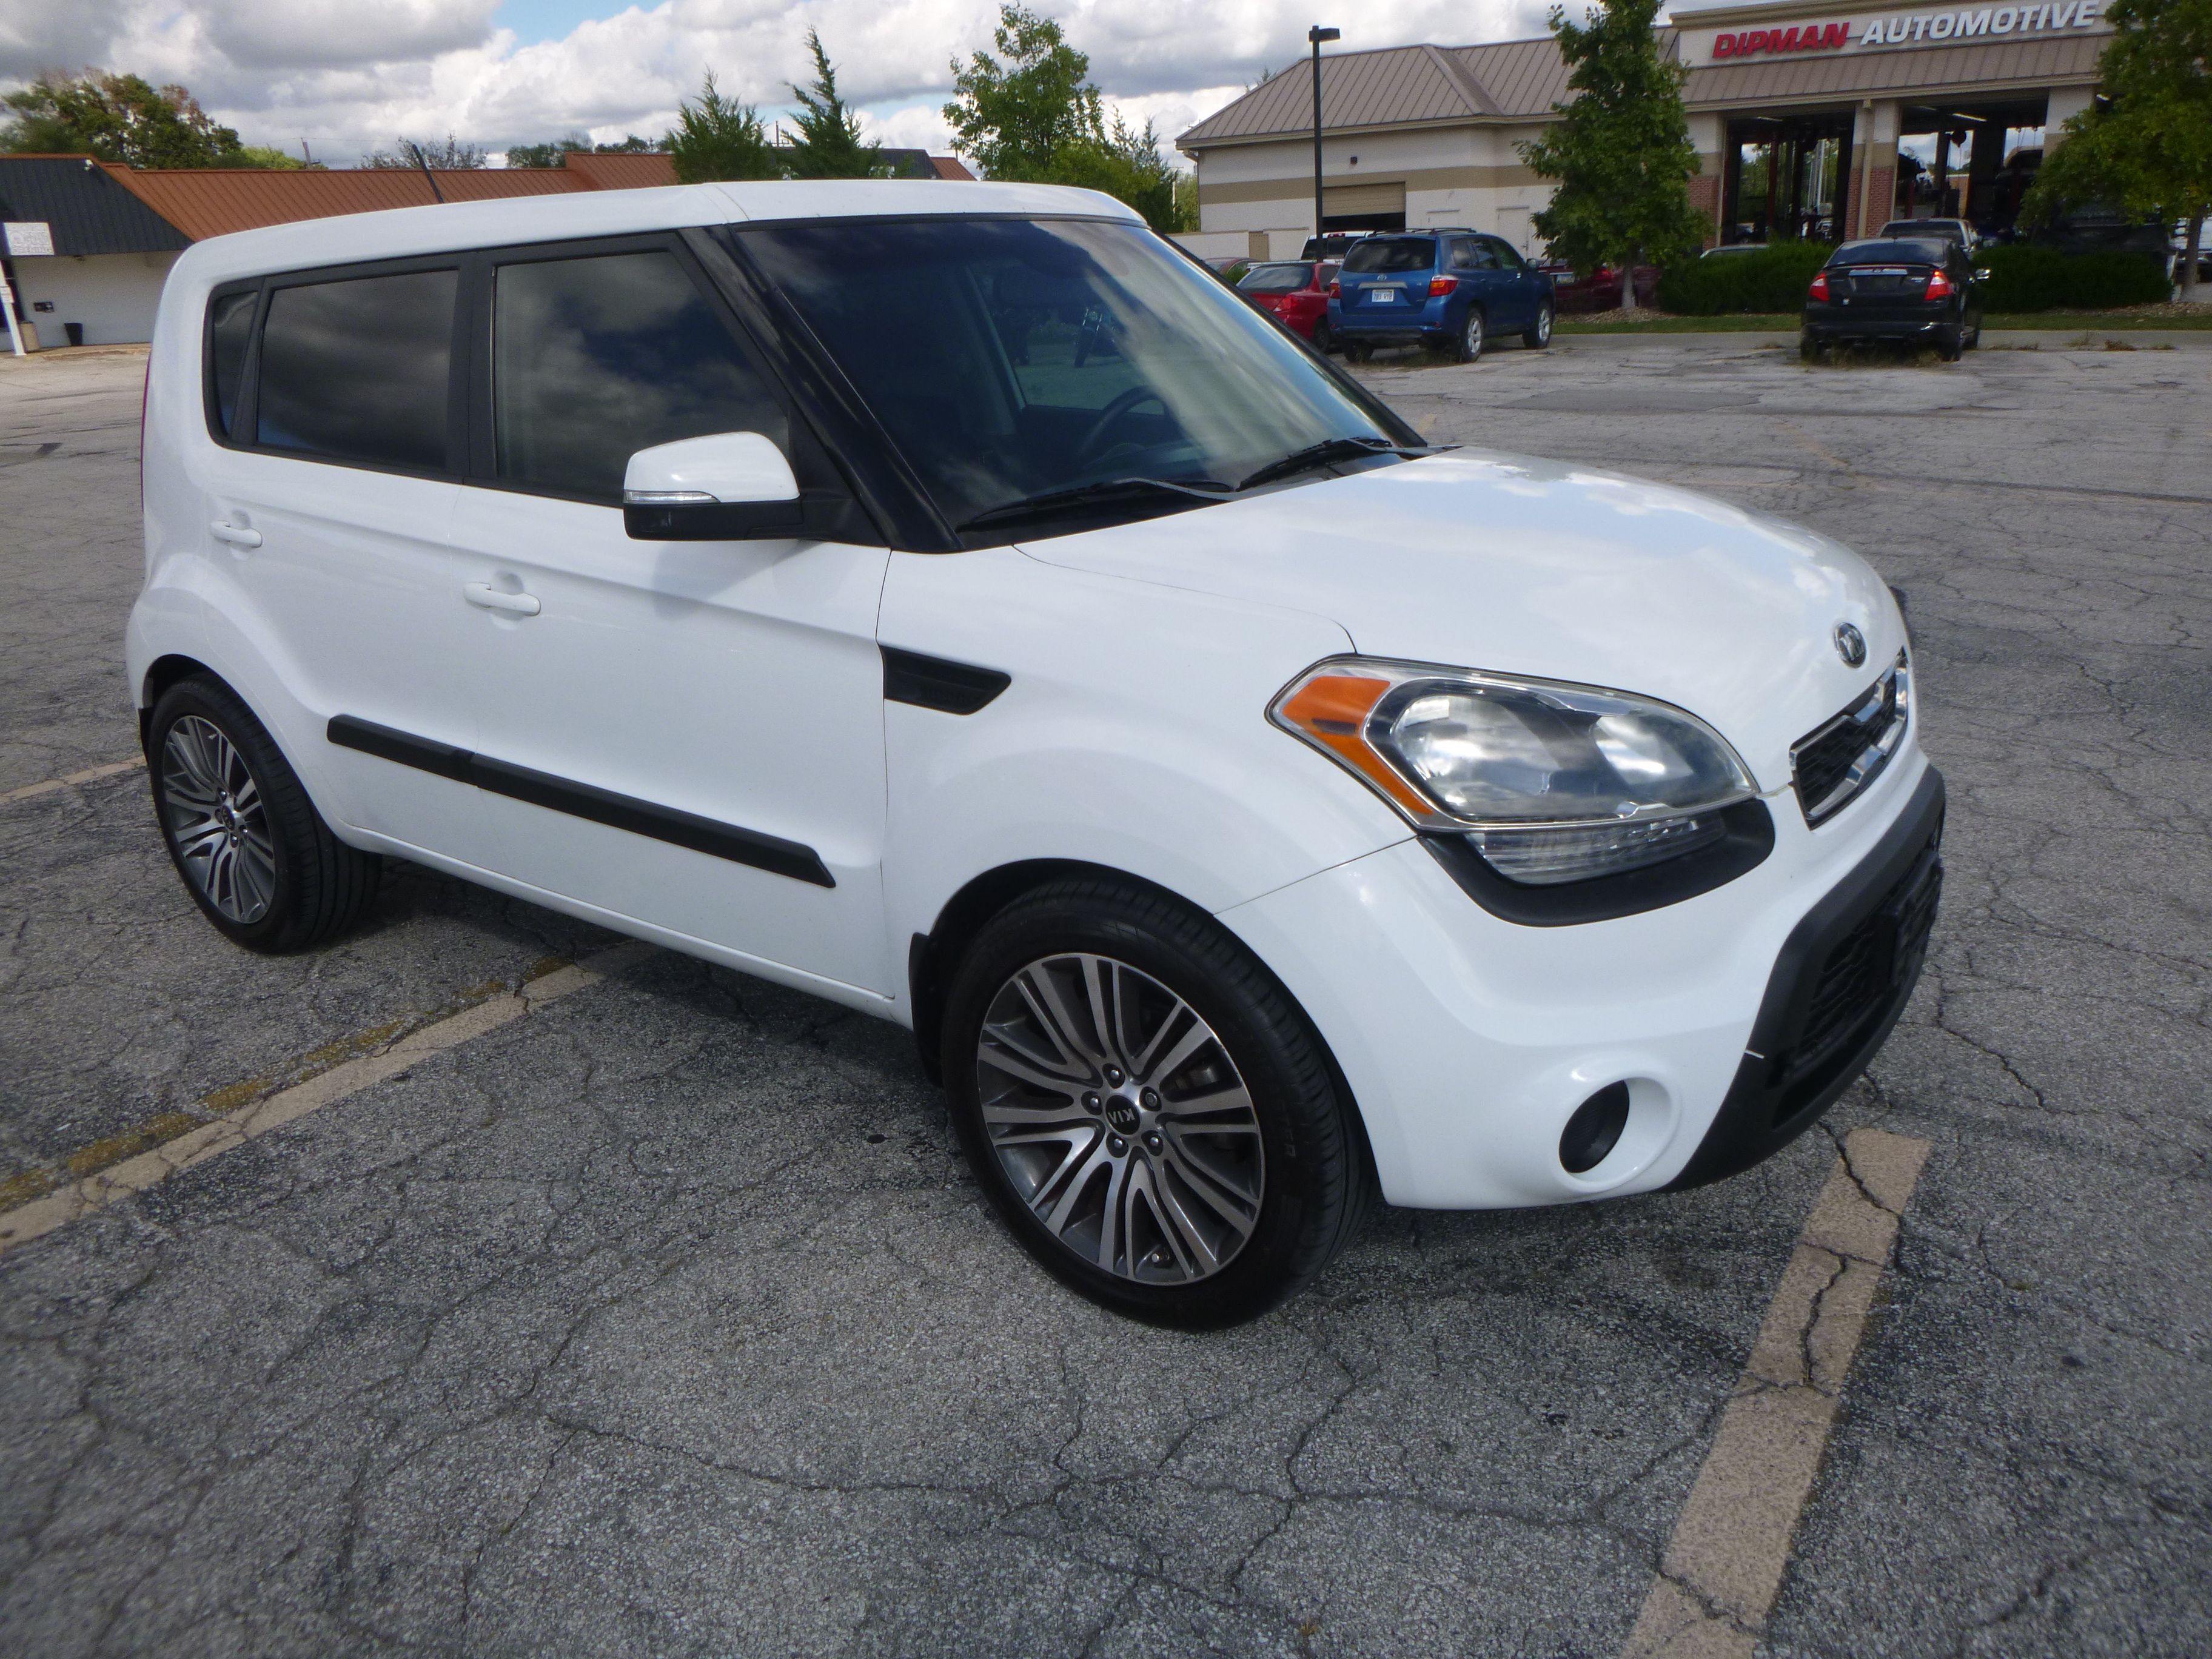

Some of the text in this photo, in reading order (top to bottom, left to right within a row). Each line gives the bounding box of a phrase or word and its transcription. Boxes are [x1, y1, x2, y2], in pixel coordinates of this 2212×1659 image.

[1712, 0, 2100, 59] DIPMAN AUTOMOTIVE
[1107, 1108, 1135, 1124] KIA
